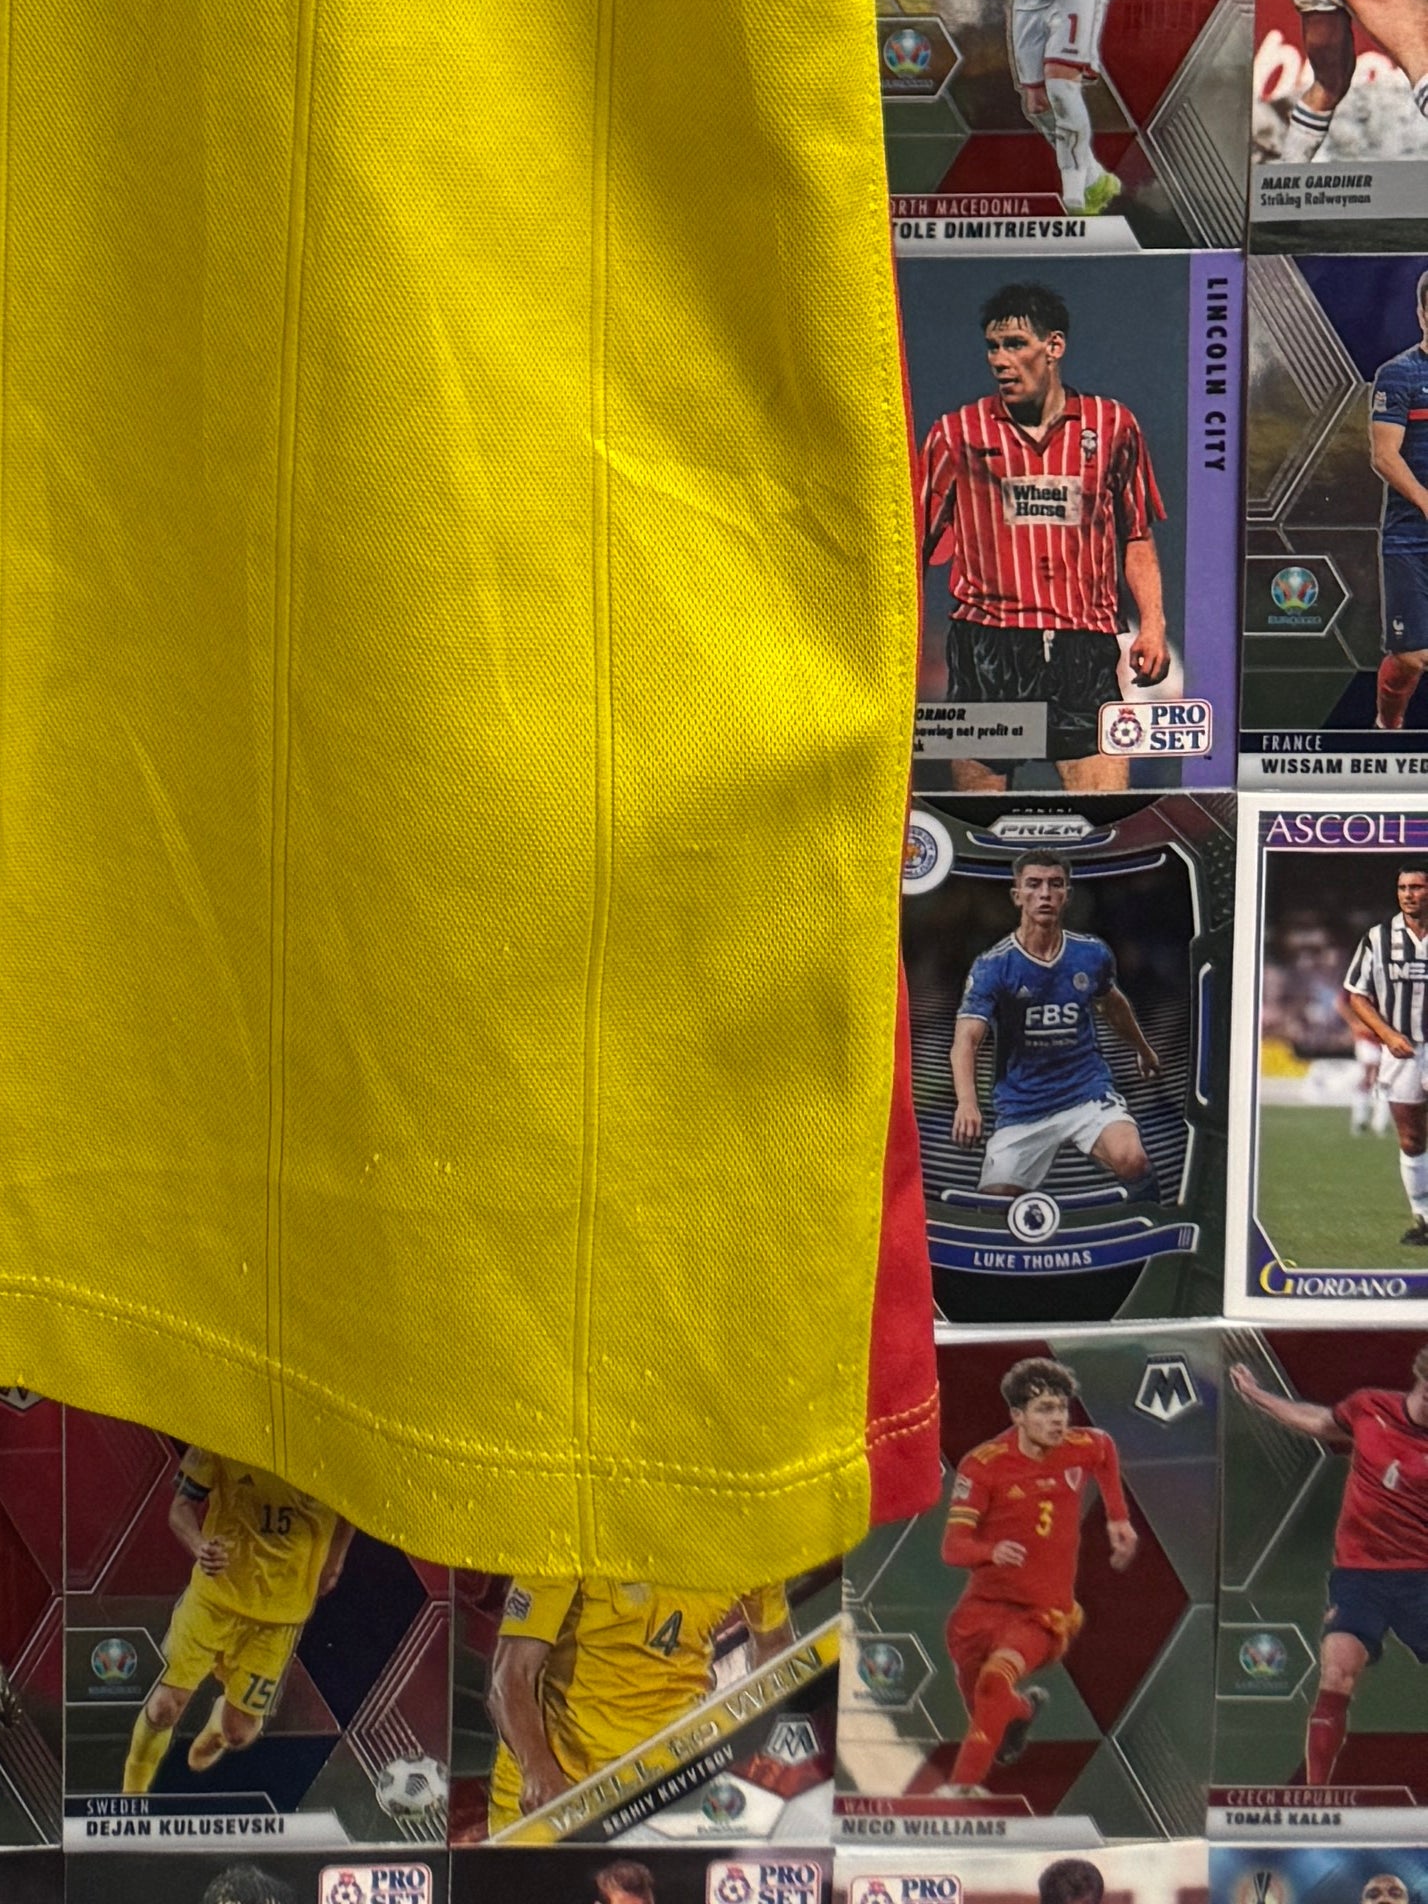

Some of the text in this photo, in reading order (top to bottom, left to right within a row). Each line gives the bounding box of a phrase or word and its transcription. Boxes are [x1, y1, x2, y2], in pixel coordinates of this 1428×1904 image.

[1260, 173, 1373, 190] MARK GARDINER
[935, 198, 1031, 215] MACEDONIA
[1259, 192, 1372, 208] Striking Railwayman
[943, 219, 1087, 241] DIMITRIEVSKI
[1203, 277, 1229, 472] LINCOLN CITY
[1013, 484, 1069, 503] Wheel
[1014, 501, 1067, 520] Horse
[1150, 705, 1206, 726] PRO
[1149, 729, 1206, 751] SET
[1261, 734, 1323, 752] FRANCE
[1261, 756, 1388, 775] WISSAM BEN
[1266, 812, 1407, 845] ASCOLI
[1024, 1002, 1080, 1026] FBS
[973, 1248, 1093, 1269] LUKE THOMAS
[1259, 1258, 1407, 1297] GIORDANO
[259, 1505, 293, 1537] 15
[1035, 1502, 1055, 1537] 3
[650, 1610, 683, 1657] 4
[86, 1798, 150, 1816] SWEDEN
[1225, 1806, 1342, 1826] TOMÁŠ KALAS
[86, 1816, 285, 1838] DEJAN KULUSEVSKI
[843, 1818, 1007, 1837] NECO WILLIAMS
